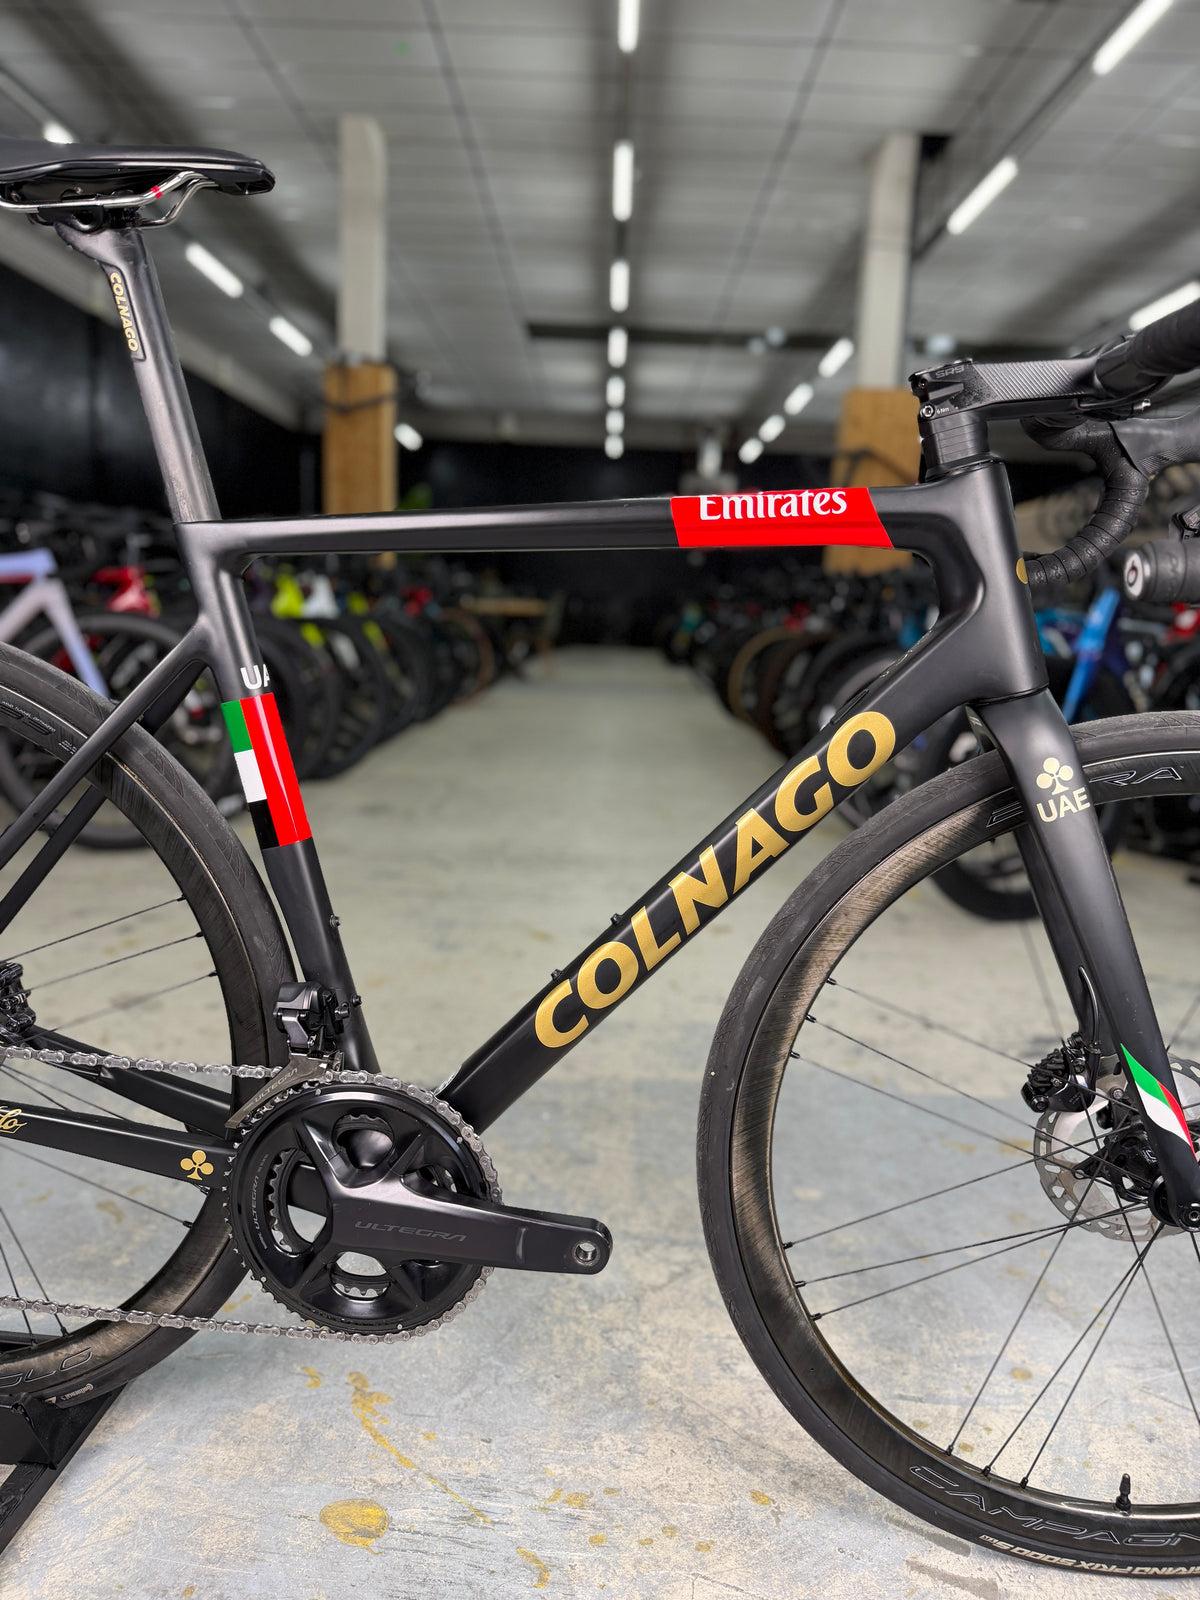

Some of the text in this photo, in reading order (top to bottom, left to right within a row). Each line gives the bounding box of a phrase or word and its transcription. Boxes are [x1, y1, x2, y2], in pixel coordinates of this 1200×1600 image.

[110, 272, 139, 352] COLNAGO
[700, 489, 847, 521] Emirates
[1036, 786, 1091, 823] UAE
[534, 711, 896, 1048] COLNAGO
[255, 1067, 298, 1103] ULTEGRA
[251, 1175, 260, 1230] ULTEGRA
[355, 1220, 467, 1242] ULTEGRA
[1010, 1546, 1079, 1567] 5000
[1074, 1560, 1132, 1575] PRIX
